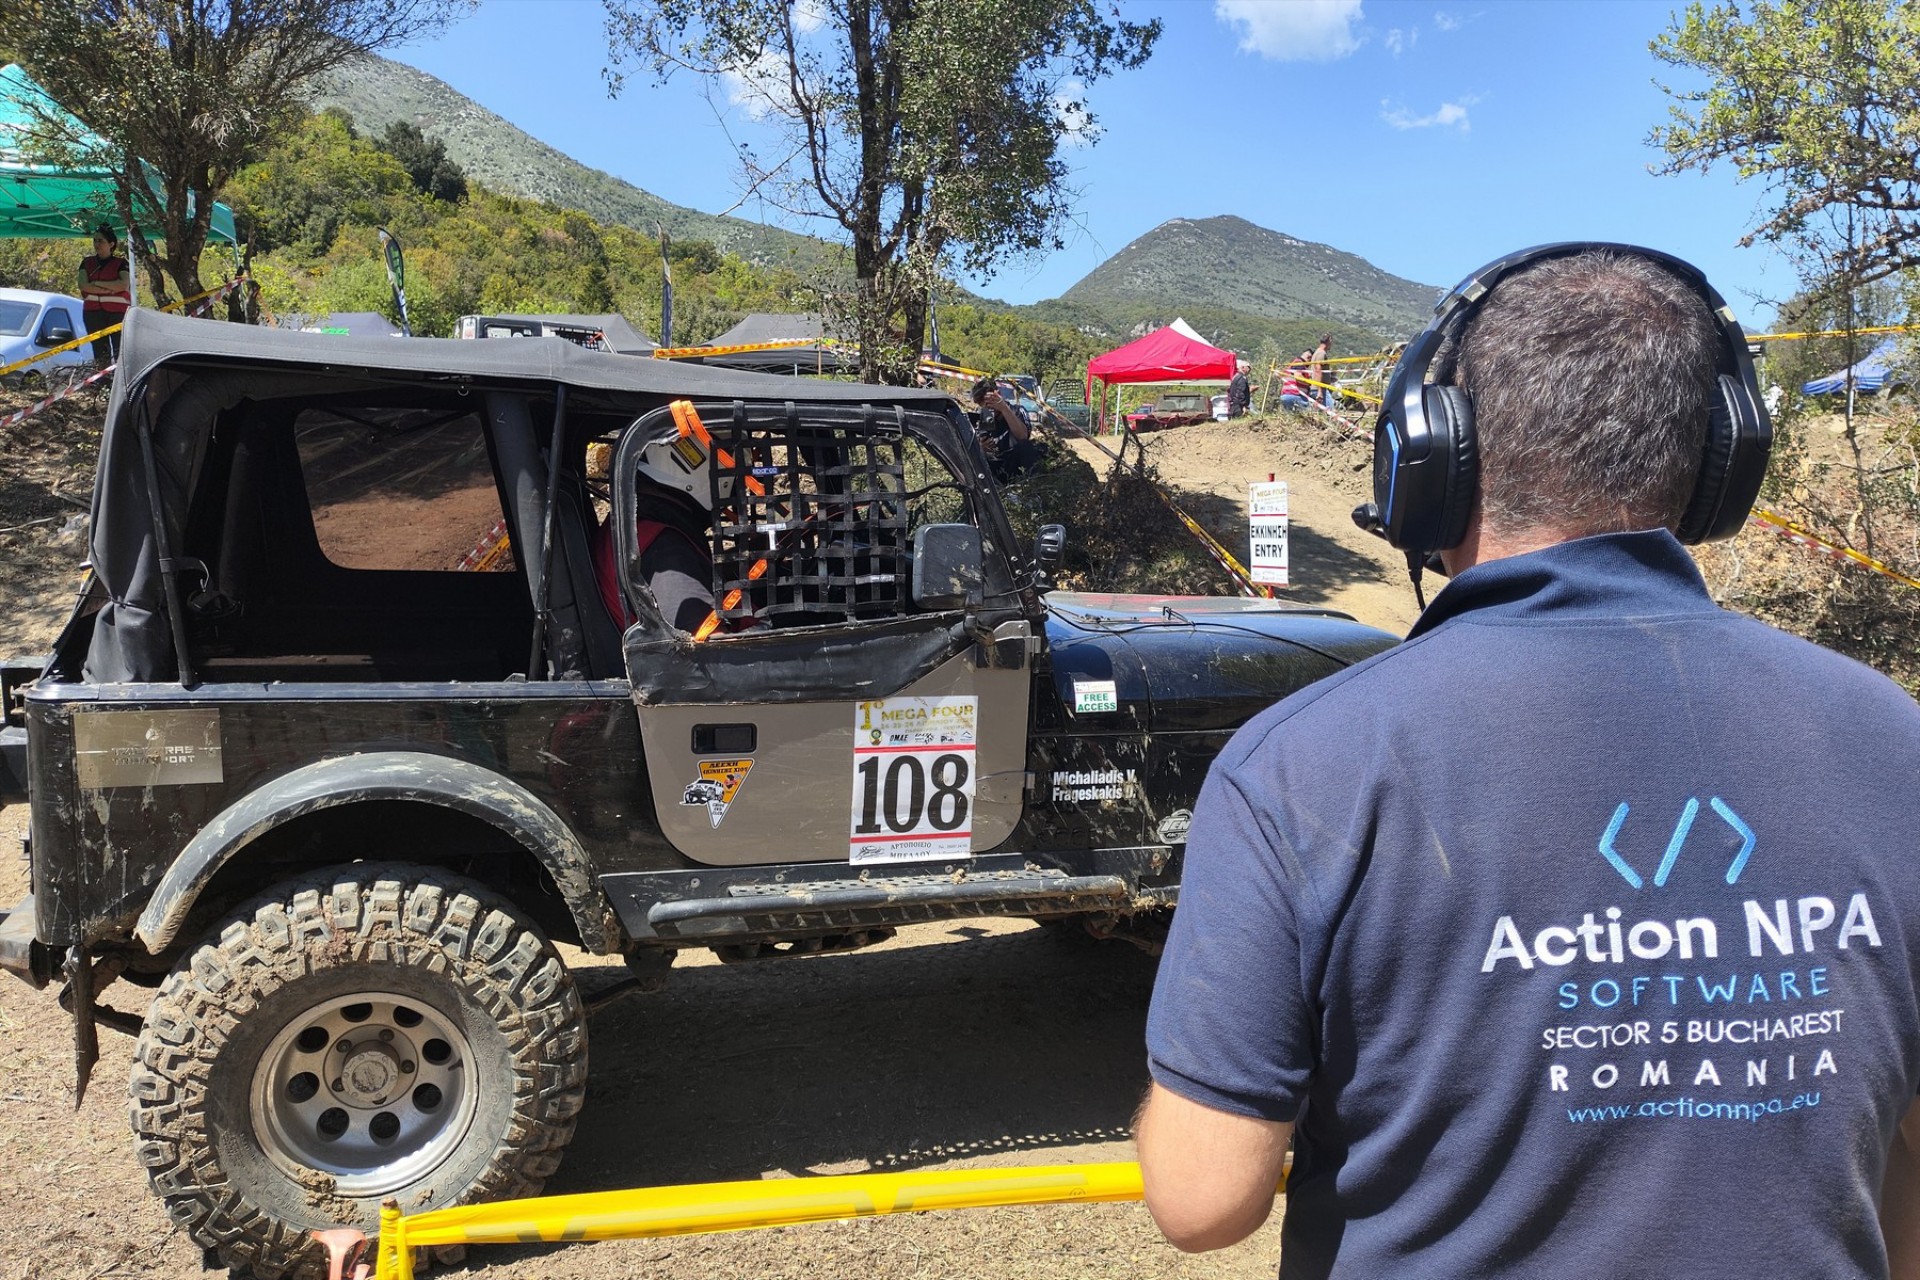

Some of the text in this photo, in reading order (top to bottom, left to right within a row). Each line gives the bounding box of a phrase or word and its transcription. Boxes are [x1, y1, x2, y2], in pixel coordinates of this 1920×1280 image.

[1255, 544, 1283, 558] ENTRY
[1077, 702, 1117, 712] ACCESS
[1084, 693, 1109, 702] FREE
[881, 707, 928, 721] MEGA
[932, 704, 974, 717] FOUR
[1053, 769, 1124, 786] Michaliadis
[855, 754, 969, 834] 108
[1052, 785, 1123, 804] Frageskakis
[1480, 893, 1883, 973] Action NPA
[1558, 968, 1830, 1010] SOFTWARE
[1542, 1010, 1845, 1050] SECTOR 5 BUCHAREST
[1549, 1049, 1838, 1092] ROMANIA
[1567, 1091, 1821, 1123] www.actionnpa.eu
